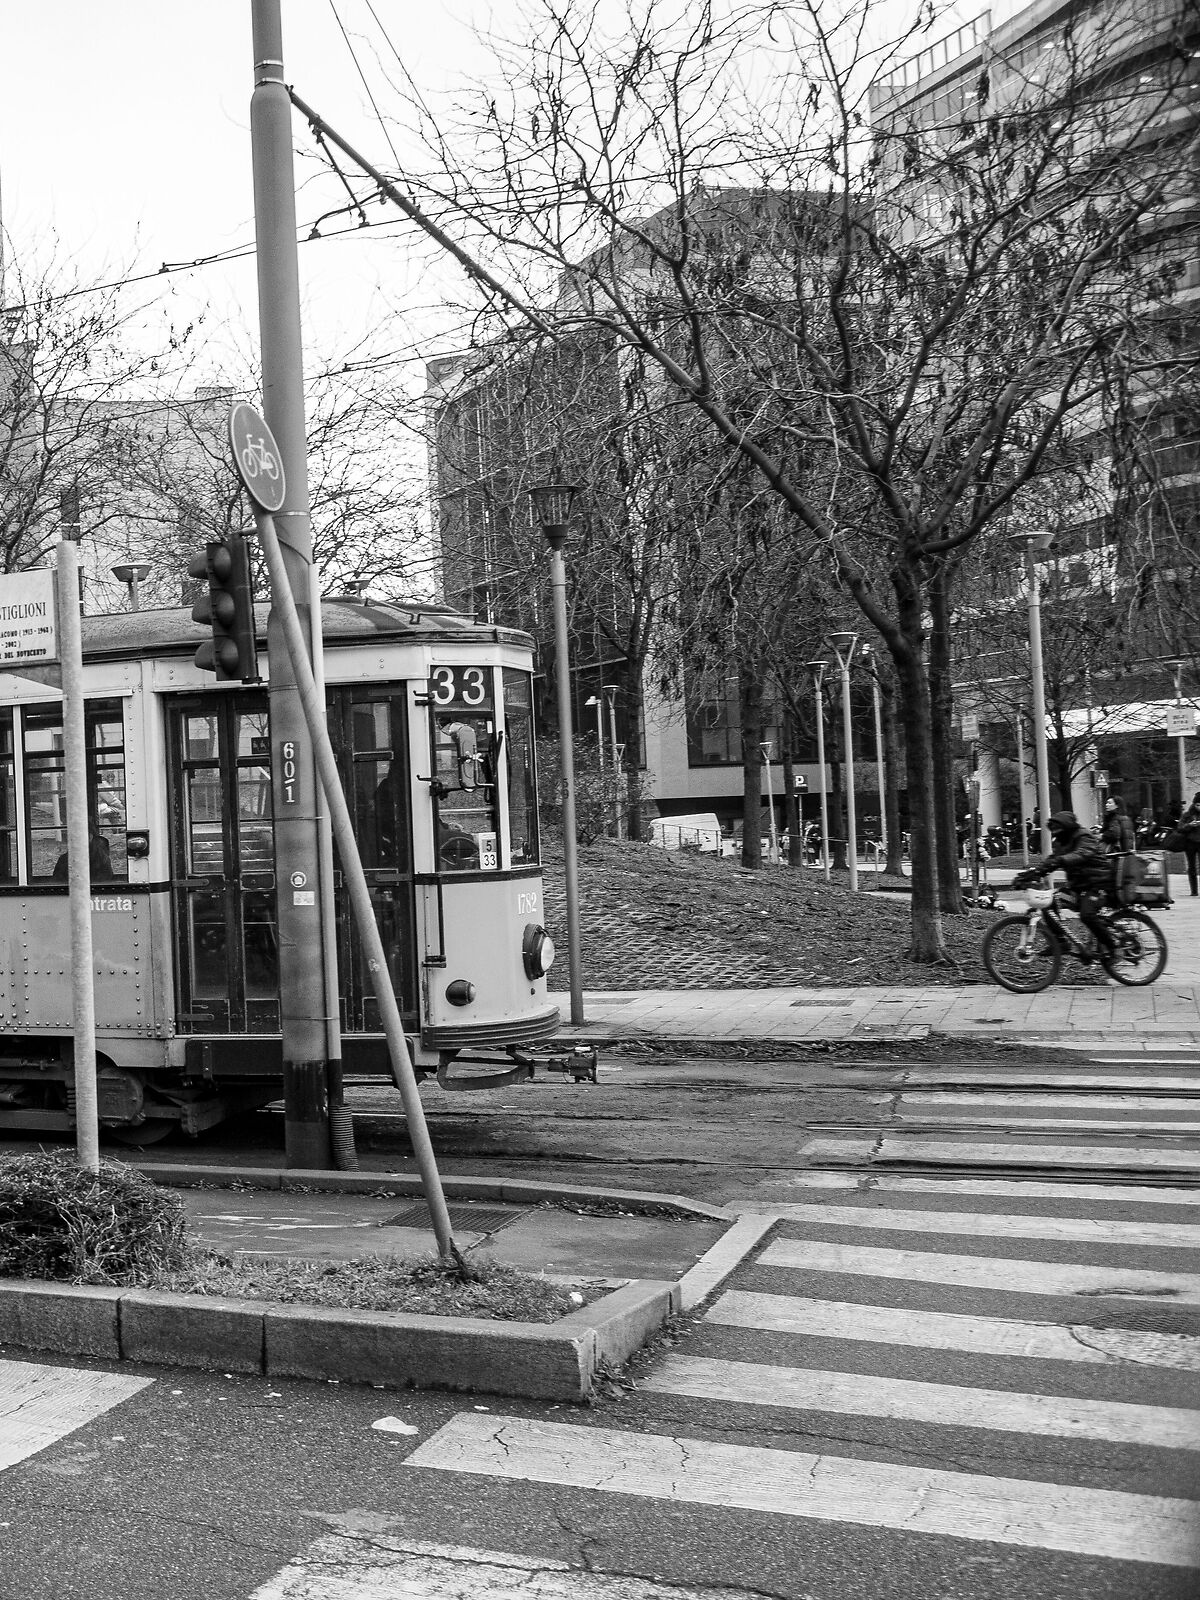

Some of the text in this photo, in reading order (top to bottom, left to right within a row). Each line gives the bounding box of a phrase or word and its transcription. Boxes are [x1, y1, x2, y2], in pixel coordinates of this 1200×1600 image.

[16, 648, 47, 657] NOVECENTO
[432, 666, 485, 705] 33
[795, 775, 805, 787] P
[486, 840, 492, 852] 5
[484, 854, 496, 866] 33
[518, 892, 537, 914] 1782
